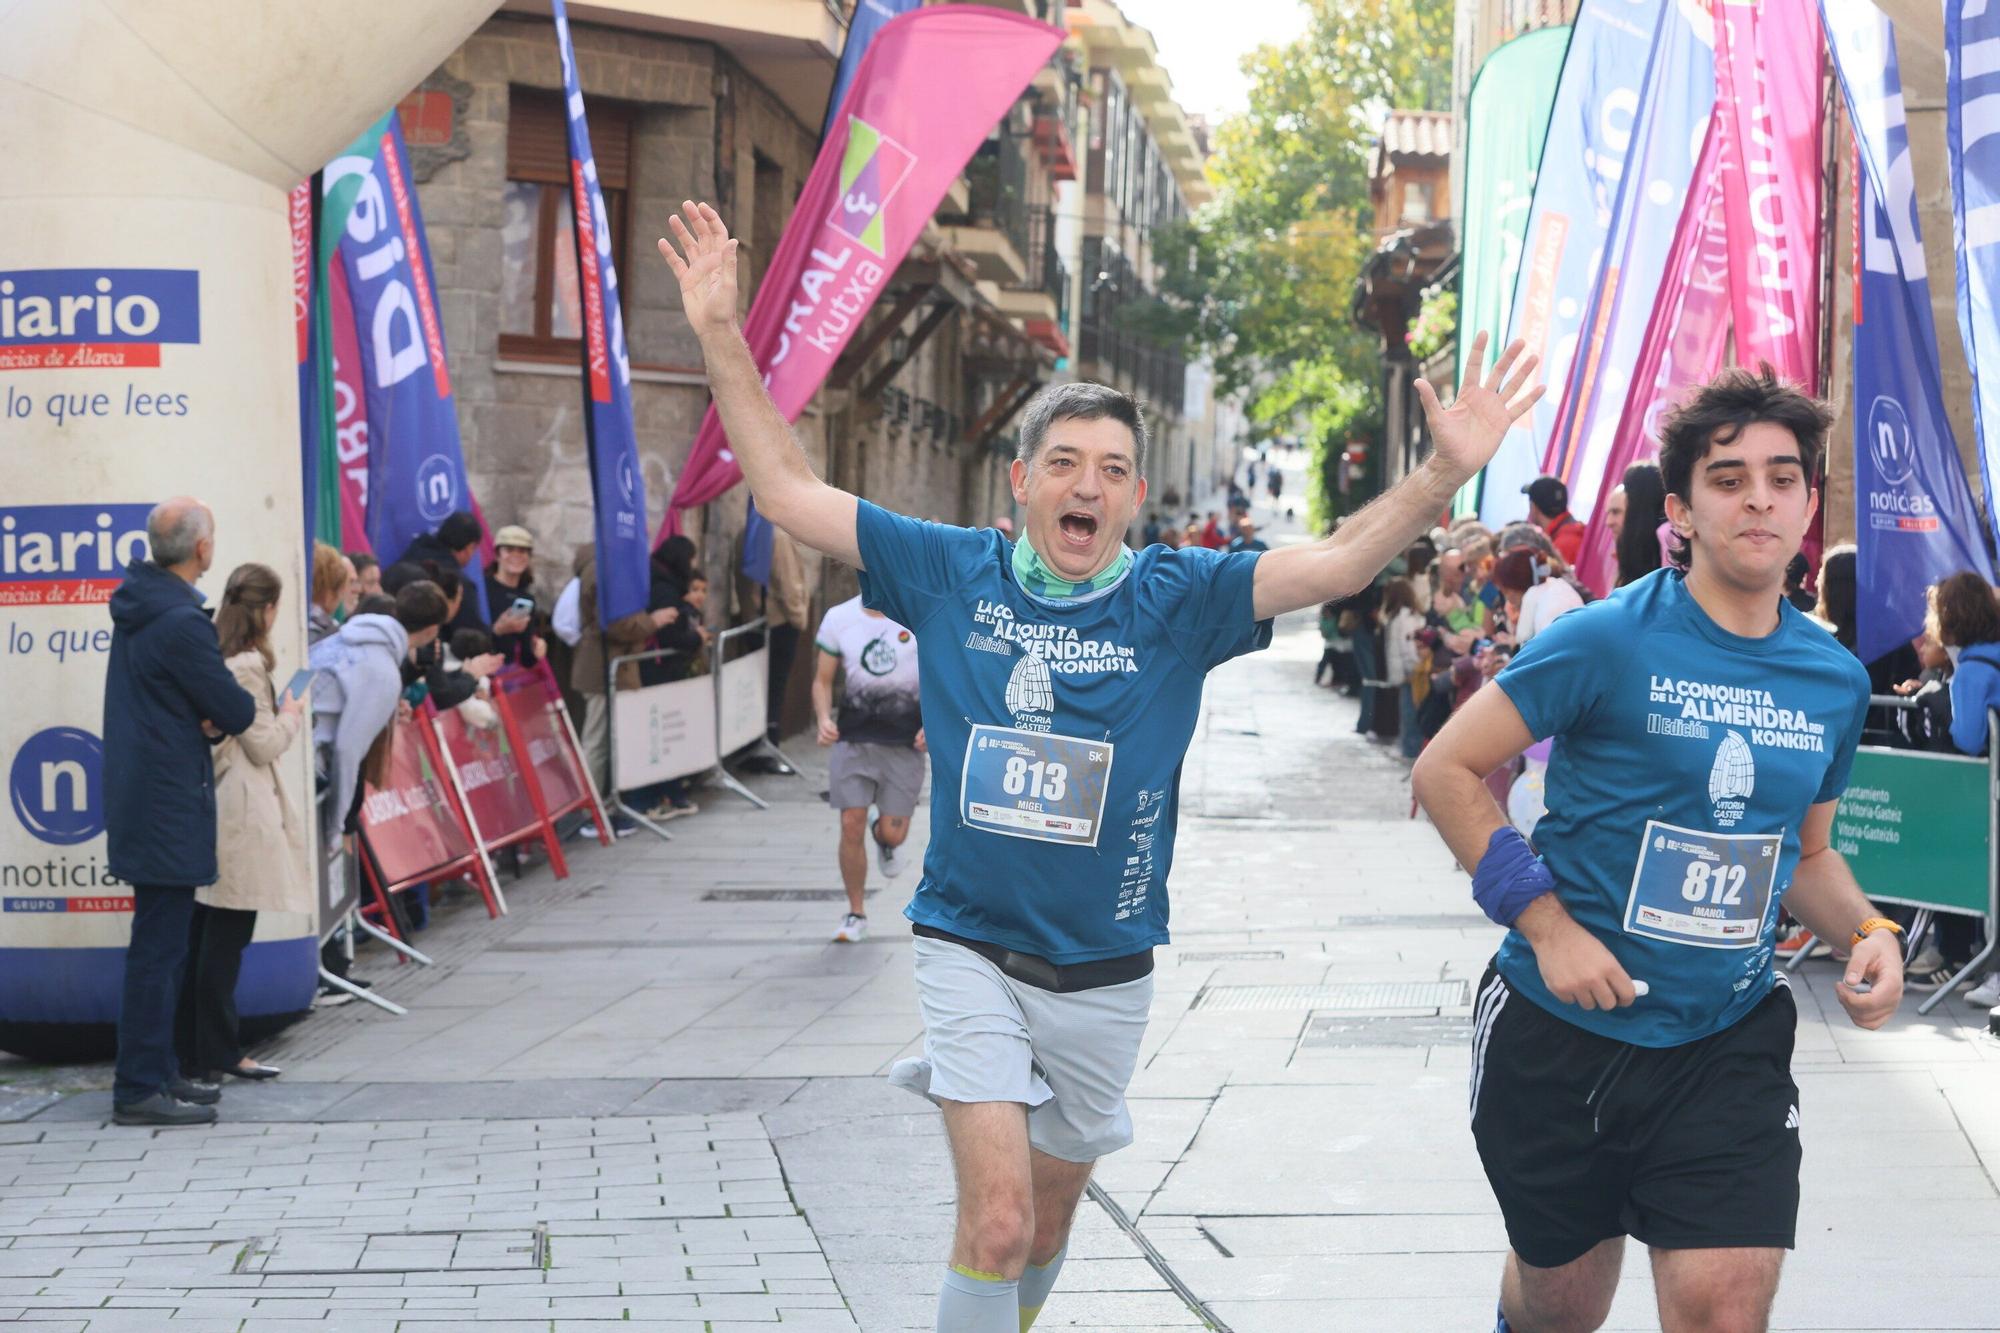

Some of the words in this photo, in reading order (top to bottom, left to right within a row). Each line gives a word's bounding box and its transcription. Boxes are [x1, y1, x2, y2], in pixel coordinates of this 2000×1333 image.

[1, 276, 161, 338] iario
[805, 259, 884, 354] kutxa
[45, 348, 65, 366] de
[69, 343, 125, 366] Álava
[7, 385, 33, 418] lo
[47, 393, 110, 427] que
[125, 383, 190, 416] lees
[1870, 488, 1935, 514] noticias
[976, 600, 992, 615] LA
[974, 613, 985, 623] DE
[986, 615, 996, 625] LA
[9, 621, 34, 654] lo
[48, 630, 111, 664] que
[975, 635, 1012, 656] Edición
[1050, 656, 1139, 674] KONKISTA
[1650, 675, 1675, 693] LA
[1676, 680, 1775, 708] CONQUISTA
[1016, 713, 1052, 725] VITORIA
[1650, 691, 1666, 703] DE
[1668, 693, 1684, 705] LA
[1681, 698, 1809, 732] ALMENDRA
[1808, 722, 1825, 735] REN
[1015, 722, 1052, 733] GASTEIZ
[1662, 717, 1710, 740] Edición
[1751, 729, 1825, 753] KONKISTA
[1088, 751, 1104, 763] 5K
[1002, 756, 1068, 801] 813
[1017, 800, 1045, 813] MIGEL
[1713, 809, 1744, 820] GASTEIZ
[1716, 801, 1745, 811] VITORIA
[1837, 803, 1848, 816] de
[1849, 801, 1903, 823] Vitoria-Gasteiz
[1837, 822, 1900, 844] Vitoria-Gasteizko
[1761, 845, 1773, 857] 5K
[1837, 839, 1860, 856] Udala
[3, 856, 132, 888] noticia
[1681, 861, 1747, 905] 812
[12, 899, 56, 911] GRUPO
[77, 899, 132, 911] TALDEA
[1691, 906, 1727, 919] IMANOL
